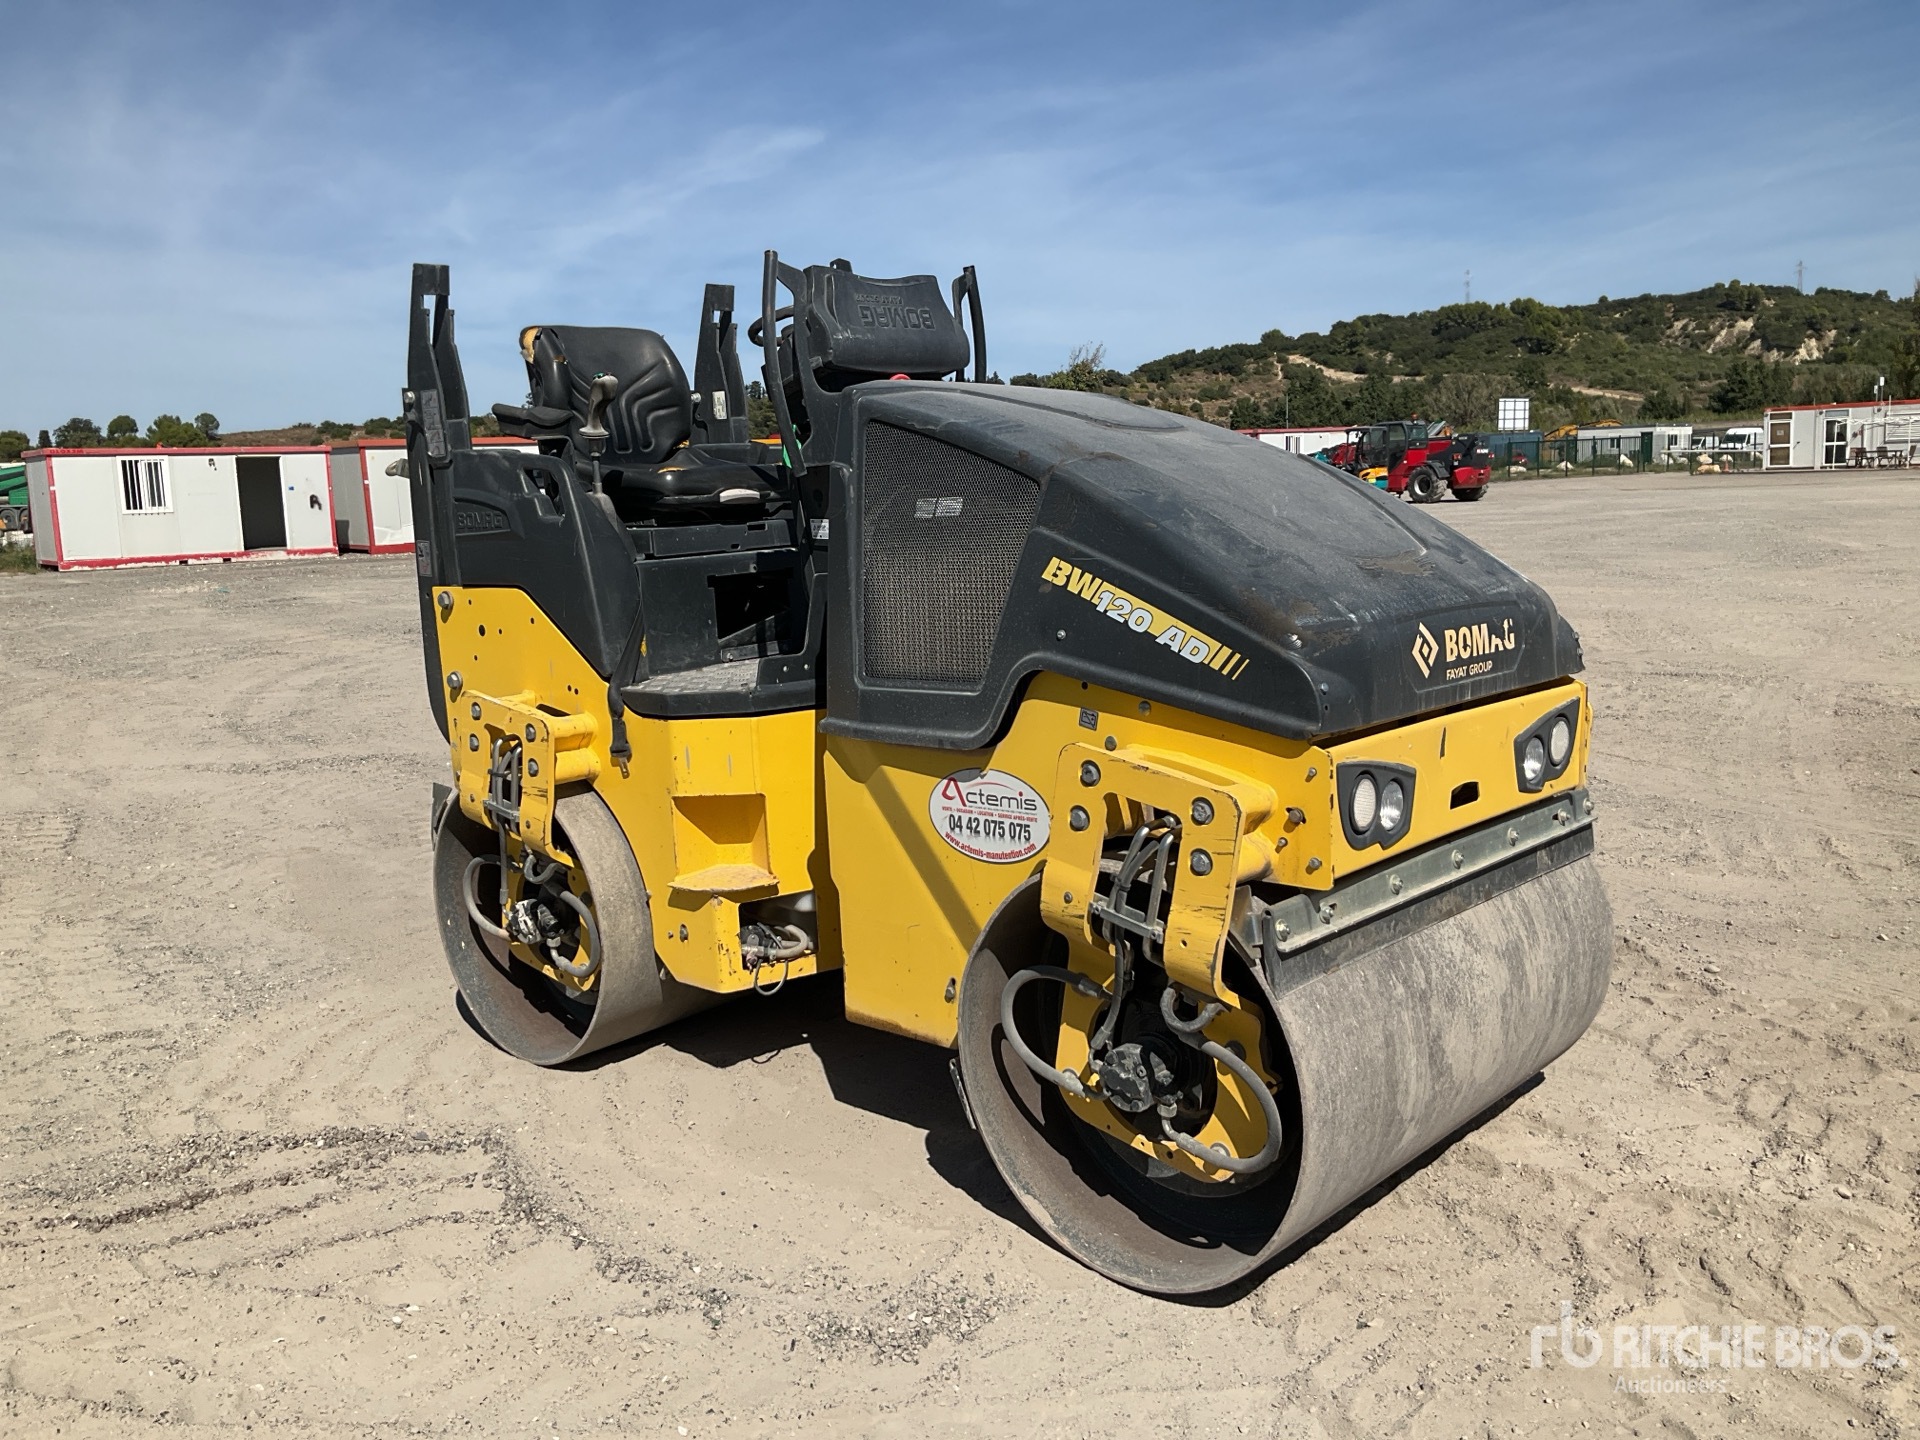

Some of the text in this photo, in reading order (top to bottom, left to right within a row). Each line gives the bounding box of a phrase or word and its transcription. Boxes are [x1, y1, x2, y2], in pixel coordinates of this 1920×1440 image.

[858, 305, 936, 331] BOMAG
[1446, 660, 1493, 680] FAYAT GROUP
[941, 777, 1037, 811] Actemis
[949, 814, 1031, 841] 04 42 075 075
[945, 831, 1037, 860] www.actemis-manutention.com
